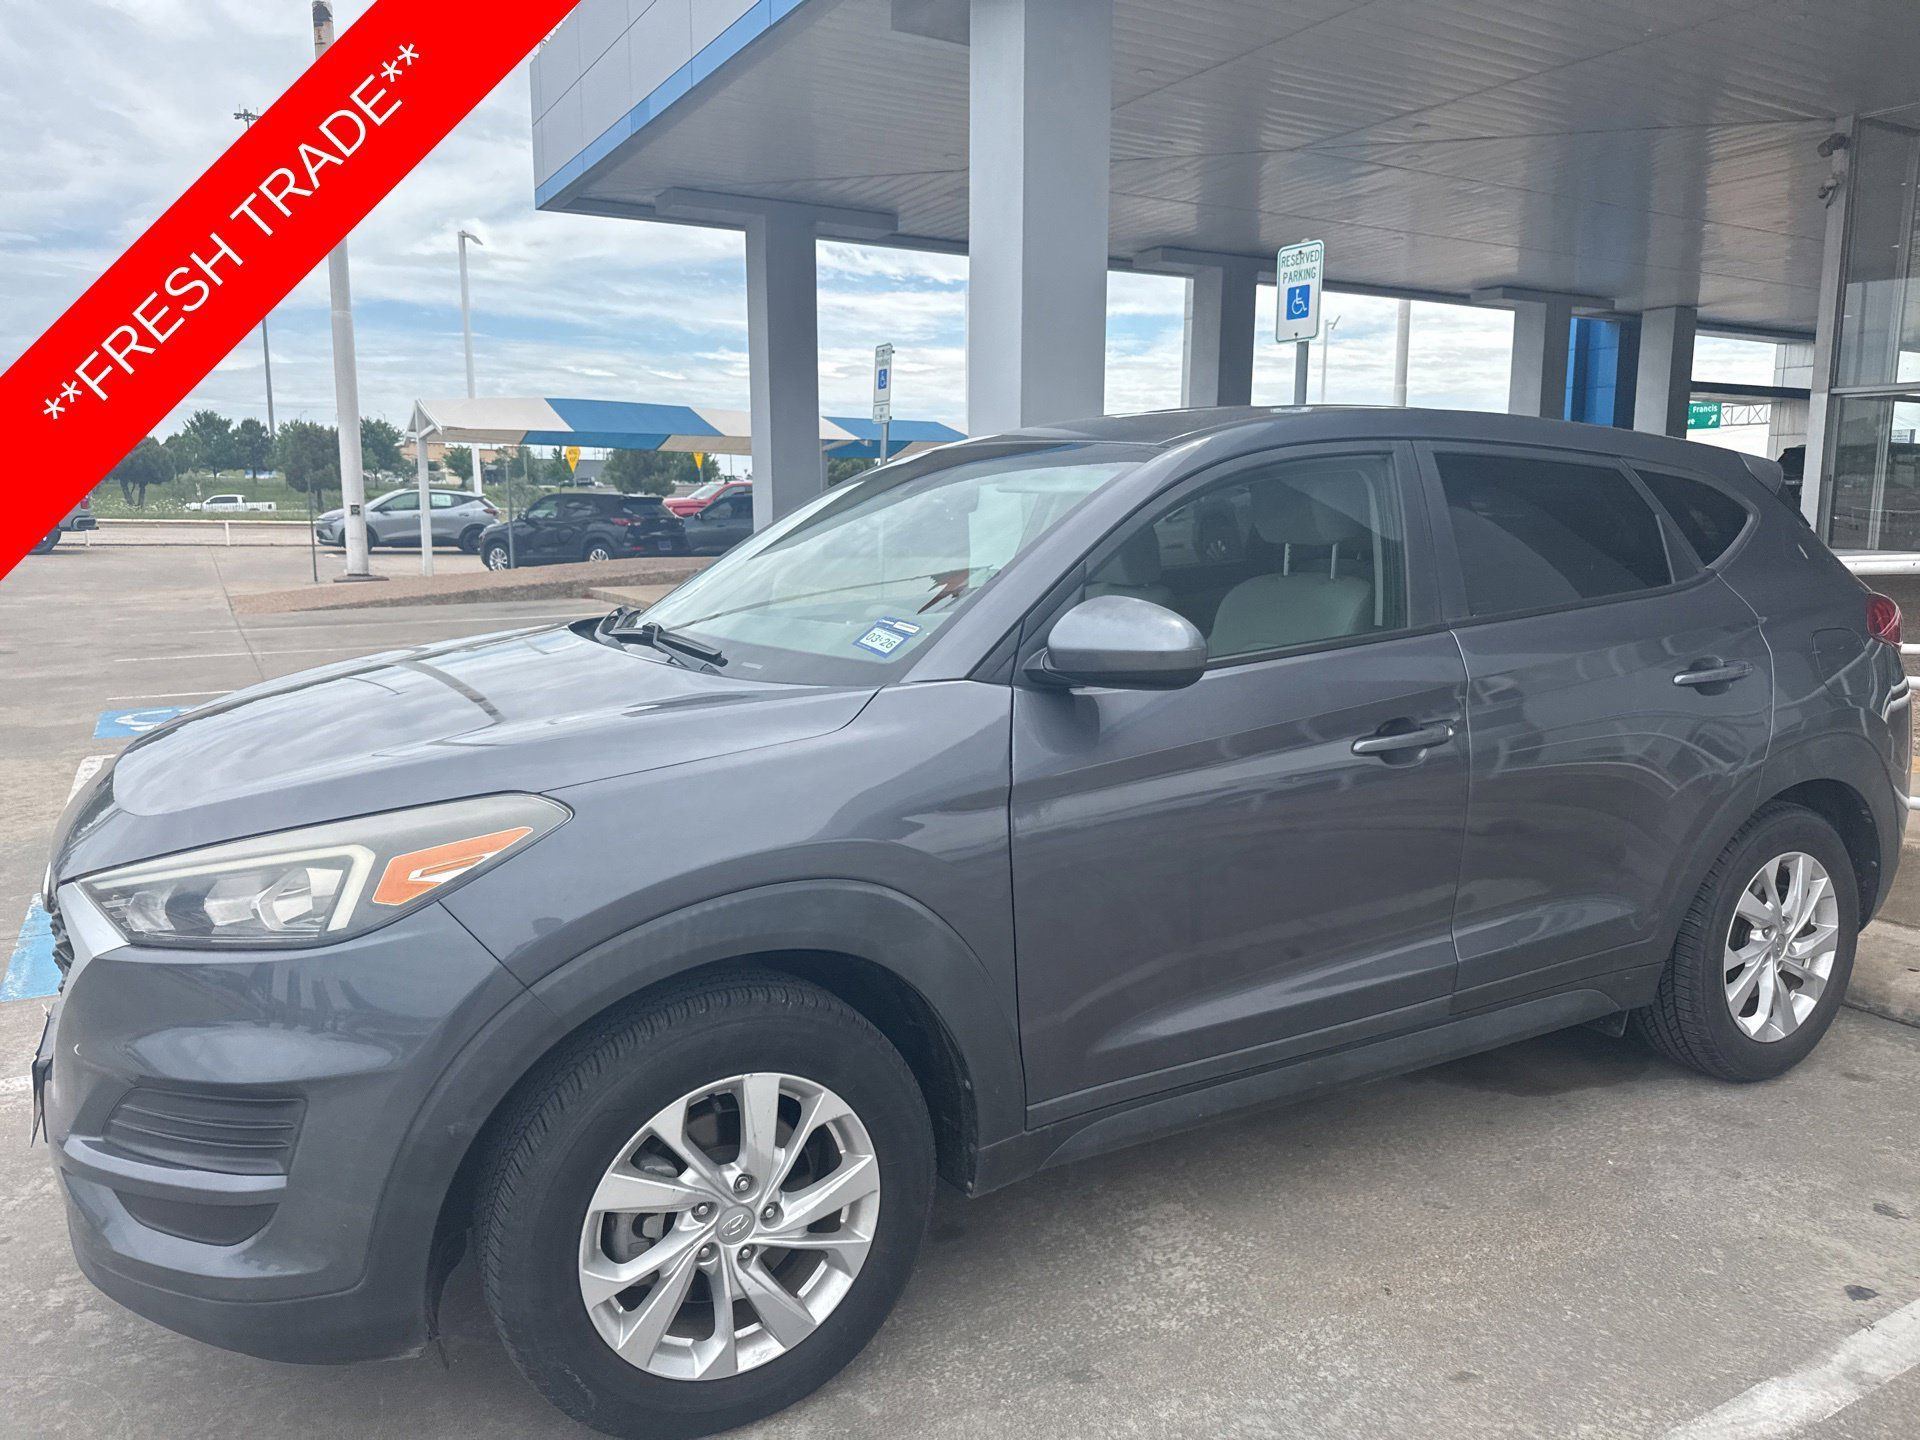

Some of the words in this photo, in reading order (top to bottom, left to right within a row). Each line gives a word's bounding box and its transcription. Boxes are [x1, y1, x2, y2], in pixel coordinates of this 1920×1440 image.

[1281, 250, 1320, 268] RESERVED
[1283, 267, 1316, 284] PARKING
[1692, 404, 1718, 413] Francis
